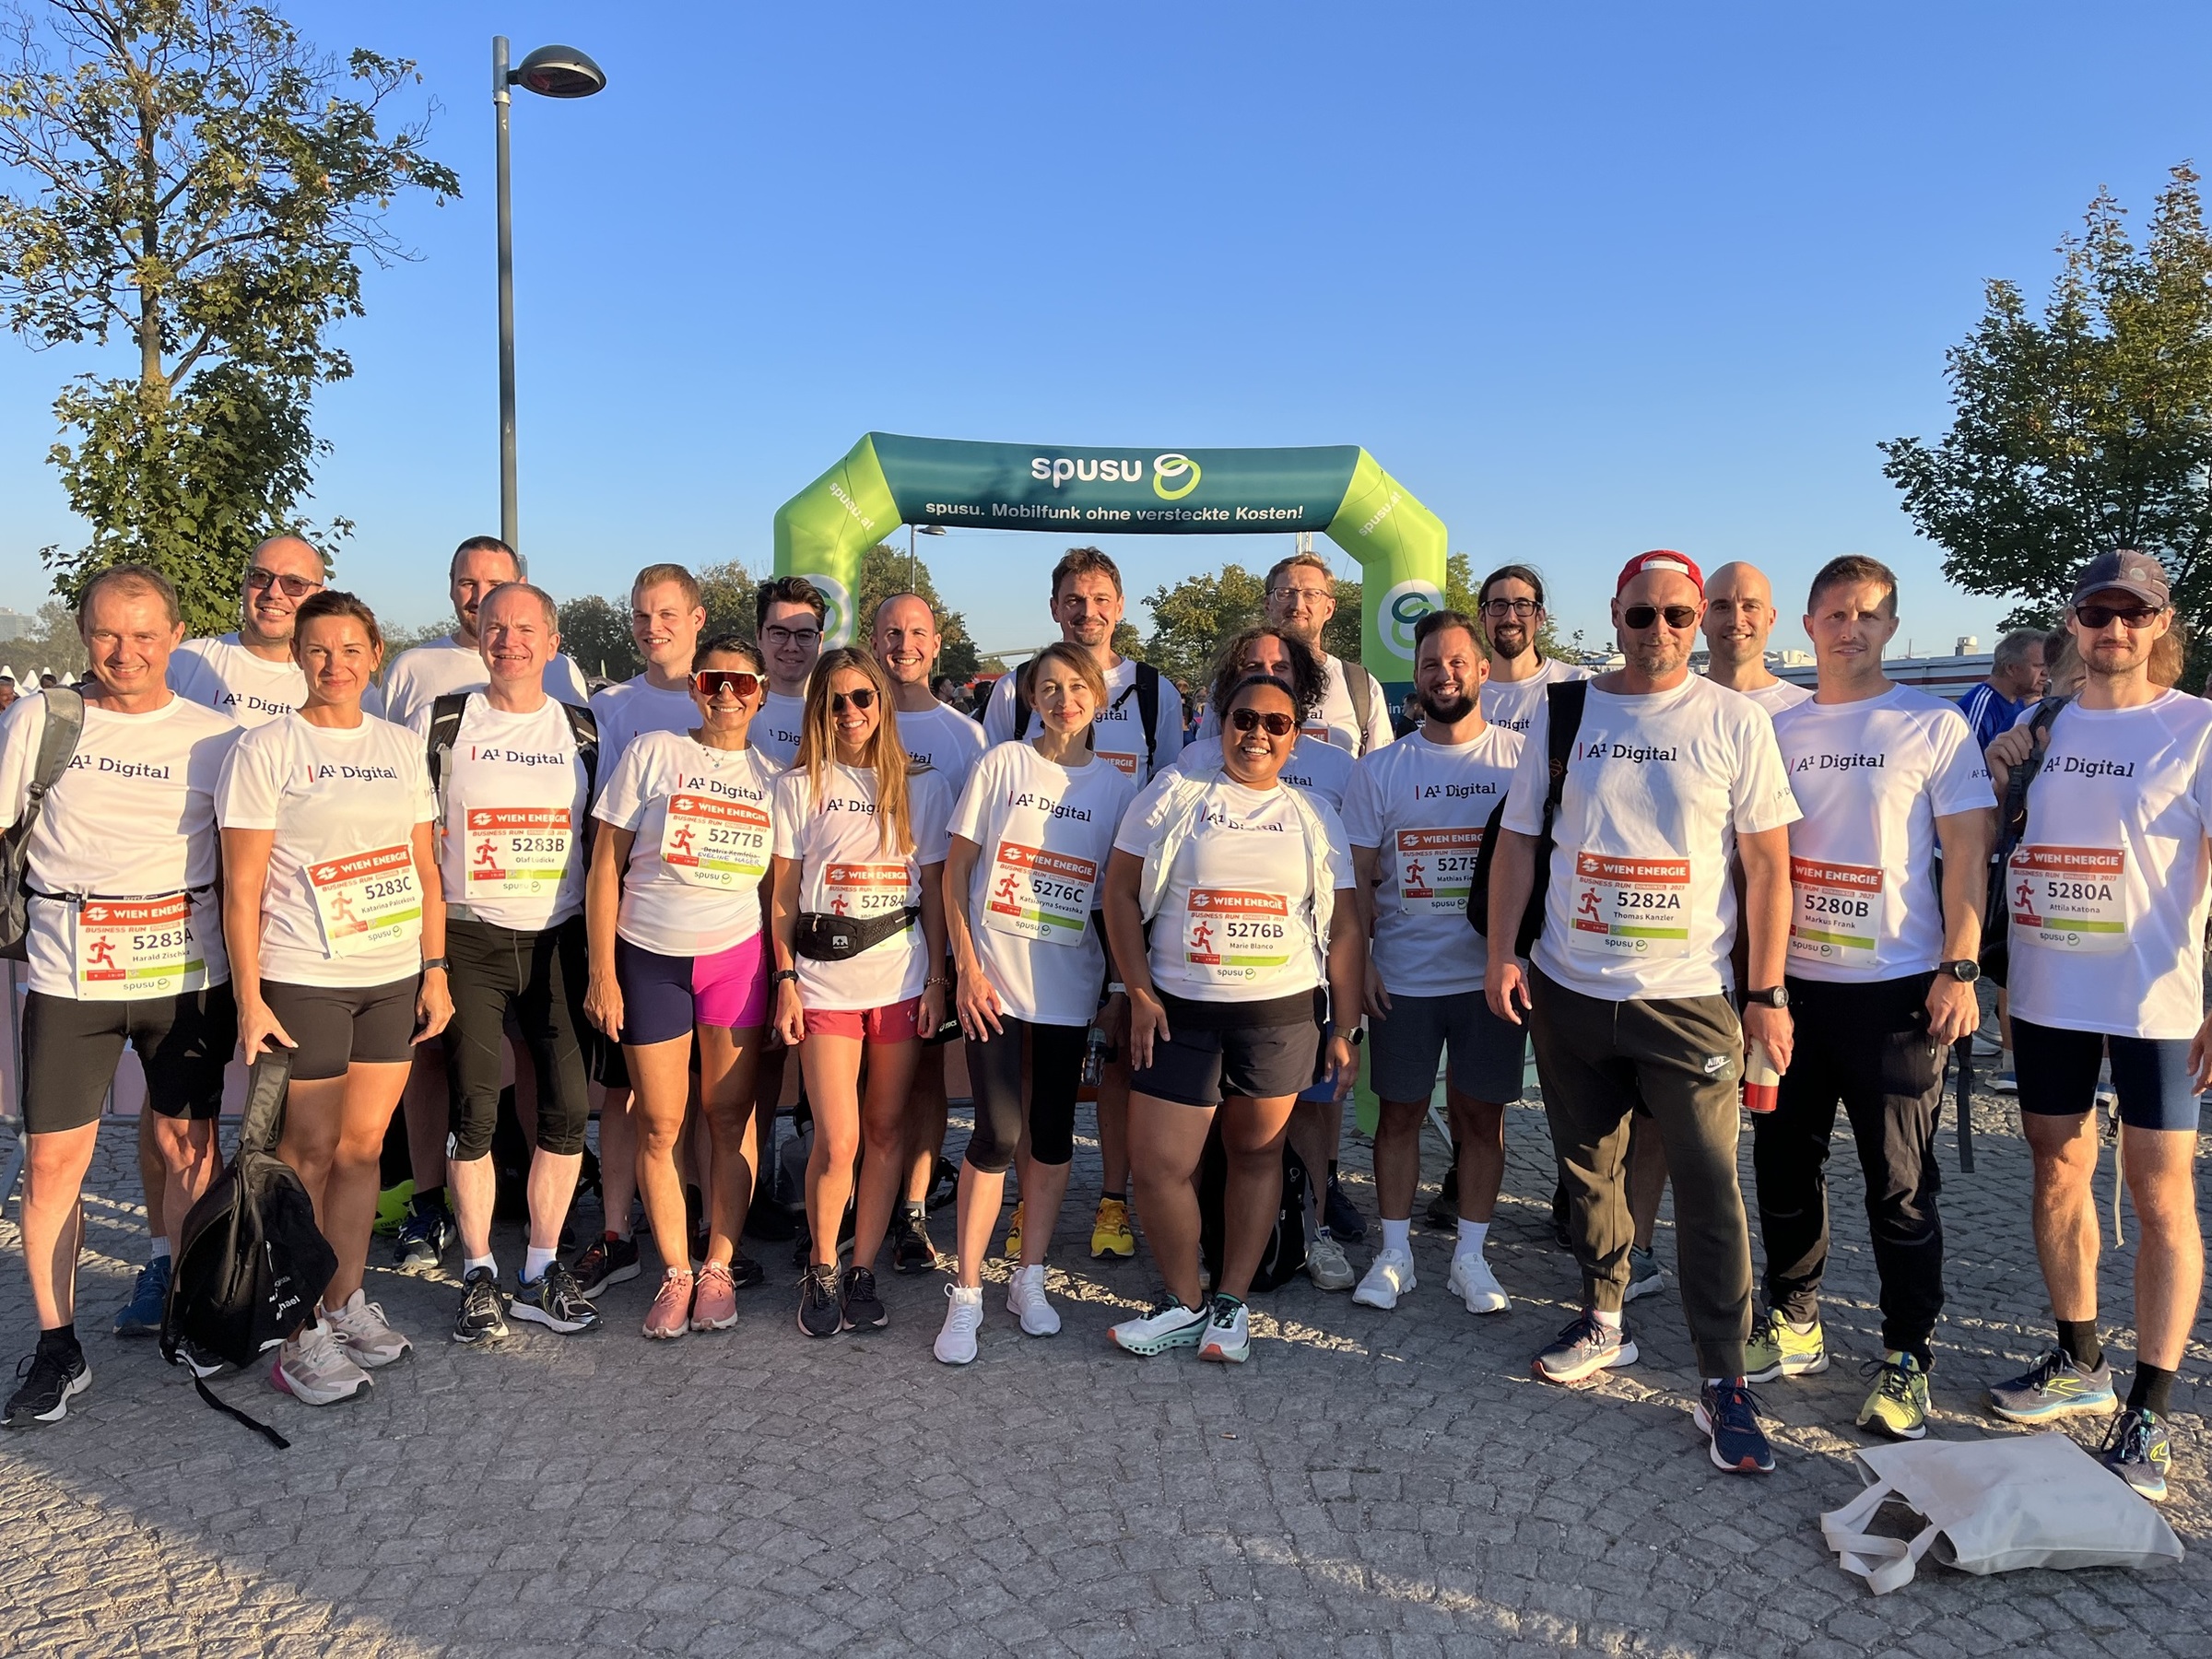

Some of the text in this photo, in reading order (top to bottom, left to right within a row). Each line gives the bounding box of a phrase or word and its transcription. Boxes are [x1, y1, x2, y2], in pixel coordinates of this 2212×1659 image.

[1030, 457, 1142, 488] spusu
[830, 482, 875, 531] spusu.at
[925, 502, 1304, 521] spusu. Mobilfunk ohne versteckte Kosten!
[1359, 491, 1402, 536] spusu.at
[247, 696, 293, 715] Digit
[1094, 710, 1128, 723] gital
[507, 750, 565, 766] Digital
[1611, 744, 1677, 764] Digital
[98, 758, 170, 780] Digital
[1819, 754, 1885, 771] Digital
[2064, 757, 2136, 778] Digital
[340, 766, 397, 781] Digital
[710, 780, 763, 800] Digital
[1445, 782, 1497, 799] Digital
[699, 802, 767, 822] WIEN ENERGIE
[1038, 797, 1092, 822] Digital
[496, 814, 568, 823] WIEN ENERGIE
[673, 815, 706, 824] BUSINESS
[512, 838, 564, 853] 5283B
[708, 828, 763, 848] 5277B
[1422, 834, 1483, 843] WIEN ENERG
[340, 851, 408, 873] WIEN ENERGIE
[1025, 853, 1093, 876] WIEN ENERGIE
[2034, 853, 2119, 865] WIEN ENERGIE
[694, 871, 720, 880] spusu
[848, 871, 874, 880] WIEN
[1603, 864, 1686, 877] WIEN ENERGIE
[1795, 865, 1878, 885] WIEN ENERGIE
[2013, 869, 2043, 877] BUSINESS
[365, 877, 412, 900] 5283C
[1579, 877, 1613, 888] BUSINESS
[1032, 879, 1085, 903] 5276C
[2047, 881, 2113, 900] 5280A
[361, 901, 389, 914] Katarina
[861, 895, 906, 909] 5278A
[1213, 897, 1284, 910] WIEN ENERGIE
[1617, 891, 1681, 909] 5282A
[1805, 894, 1869, 917] 5280B
[113, 909, 148, 919] WIEN
[1054, 902, 1083, 914] Sevashka
[1614, 912, 1643, 920] Thomas
[1805, 914, 1856, 929] Markus Frank
[1016, 921, 1040, 931] spusu
[1227, 923, 1284, 938] 5276B
[133, 927, 194, 950] 5283A
[368, 930, 392, 941] spusu
[1605, 939, 1633, 947] spusu
[2040, 933, 2065, 941] spusu
[1792, 940, 1818, 951] spusu
[133, 953, 160, 962] Harald
[1217, 969, 1243, 977] spusu
[124, 980, 155, 991] spusu
